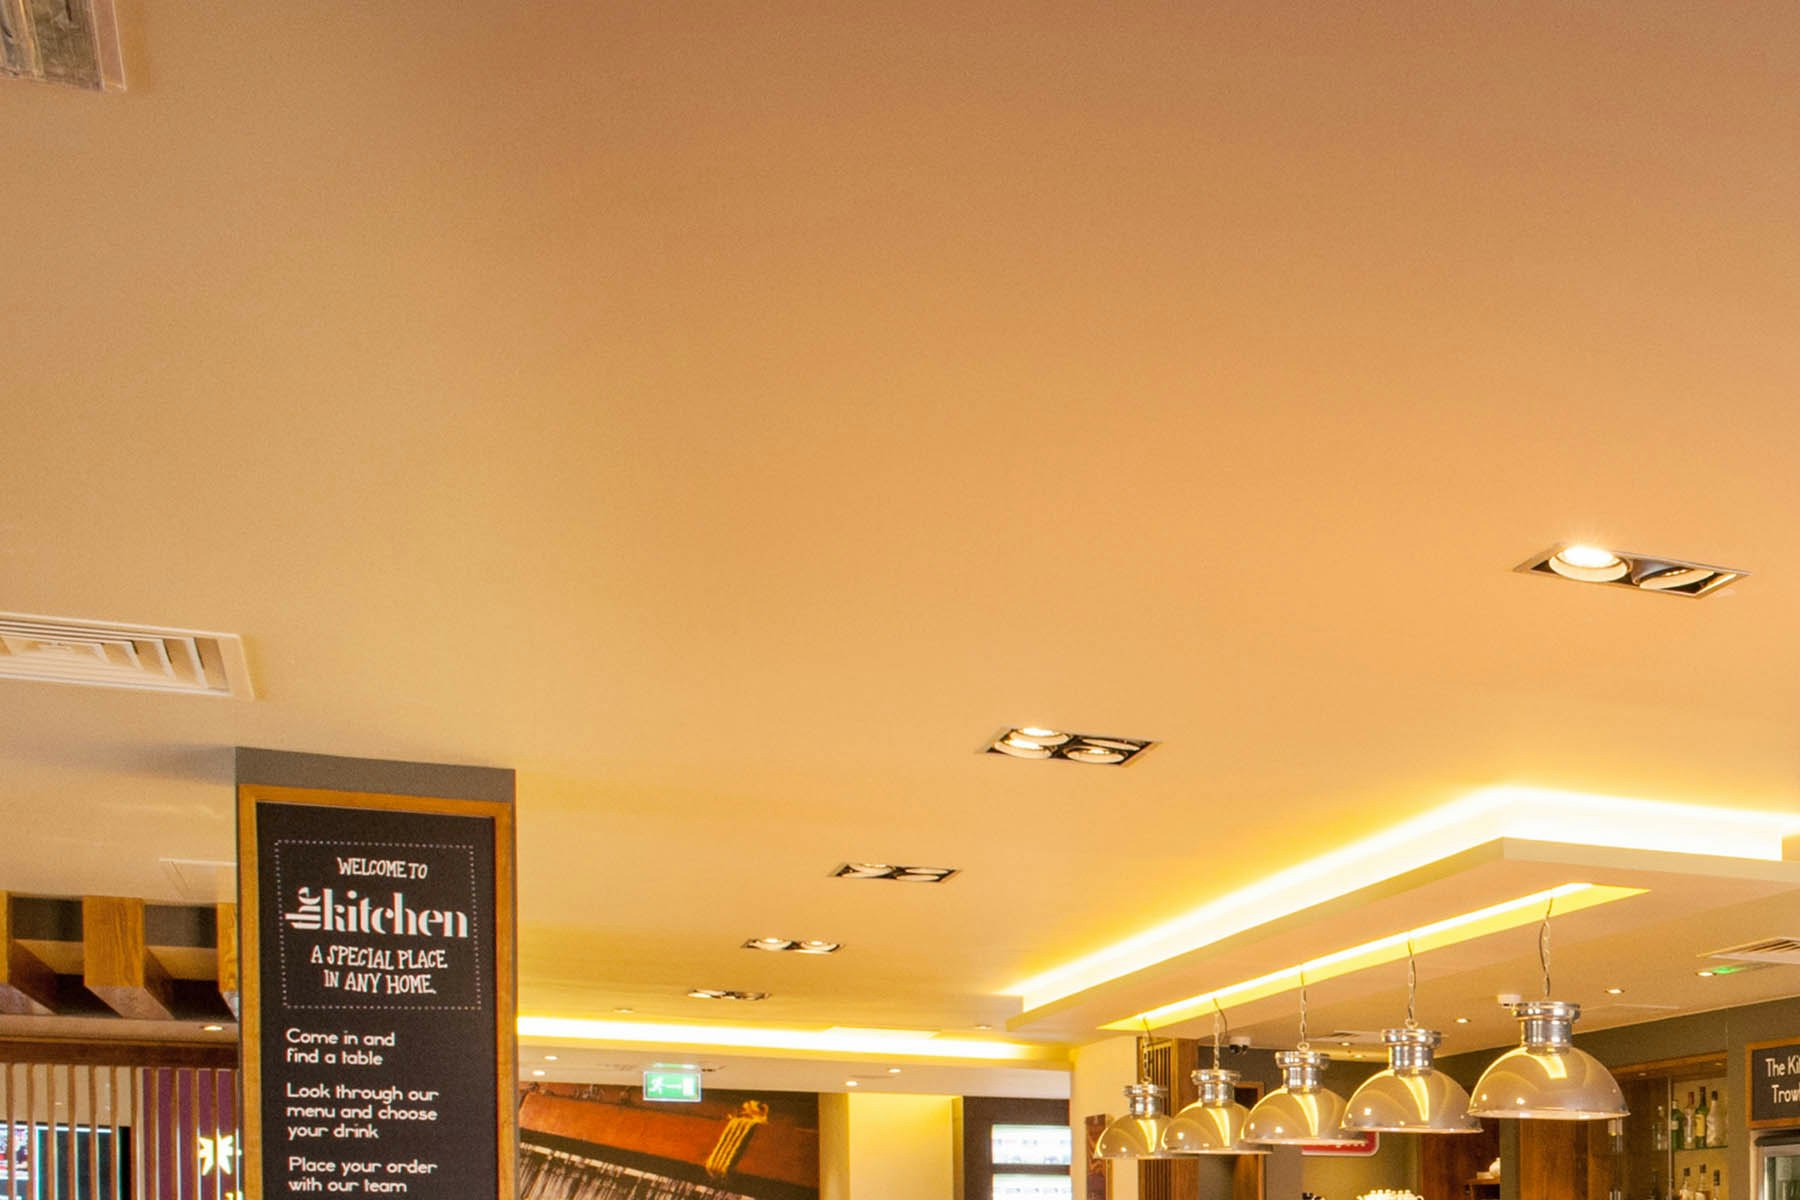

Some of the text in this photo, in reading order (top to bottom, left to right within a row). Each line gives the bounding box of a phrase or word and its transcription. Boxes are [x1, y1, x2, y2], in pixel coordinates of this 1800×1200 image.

[337, 857, 428, 879] WELCOME TO
[323, 888, 468, 938] kitchen
[310, 944, 448, 970] A SPECIAL PLACE
[324, 969, 339, 988] IN
[344, 972, 381, 993] ANY
[286, 1028, 395, 1047] Come in and
[286, 1047, 383, 1066] find a table
[1765, 1057, 1786, 1077] The
[286, 1082, 440, 1104] Look through our
[286, 1104, 438, 1121] menu and choose
[287, 1123, 379, 1140] your drink
[288, 1156, 438, 1177] Place your order
[288, 1176, 407, 1192] with our team
